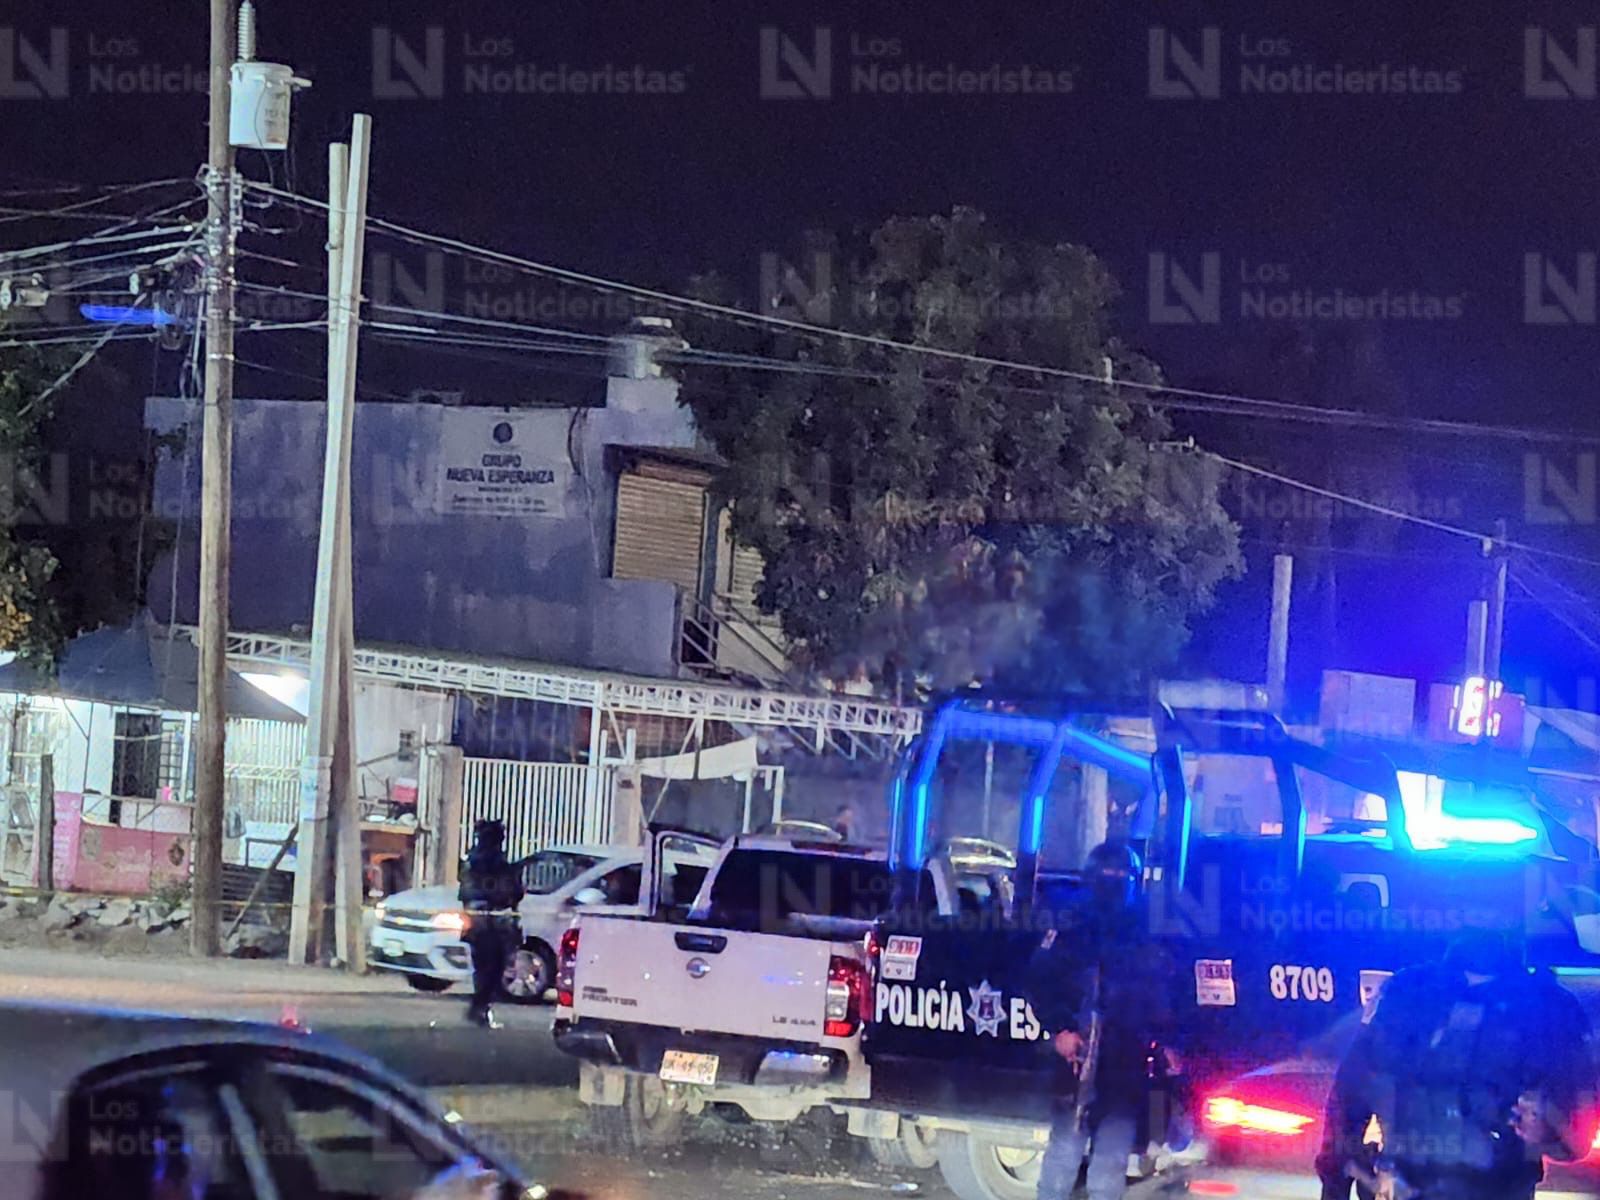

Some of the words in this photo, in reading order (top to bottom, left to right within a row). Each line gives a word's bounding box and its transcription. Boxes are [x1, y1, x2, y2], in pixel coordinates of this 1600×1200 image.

[482, 454, 522, 468] GRUPO
[446, 467, 485, 482] NUEVA
[488, 469, 555, 484] ESPERANZA
[1269, 964, 1334, 1003] 8709
[875, 980, 965, 1033] POLICÍA
